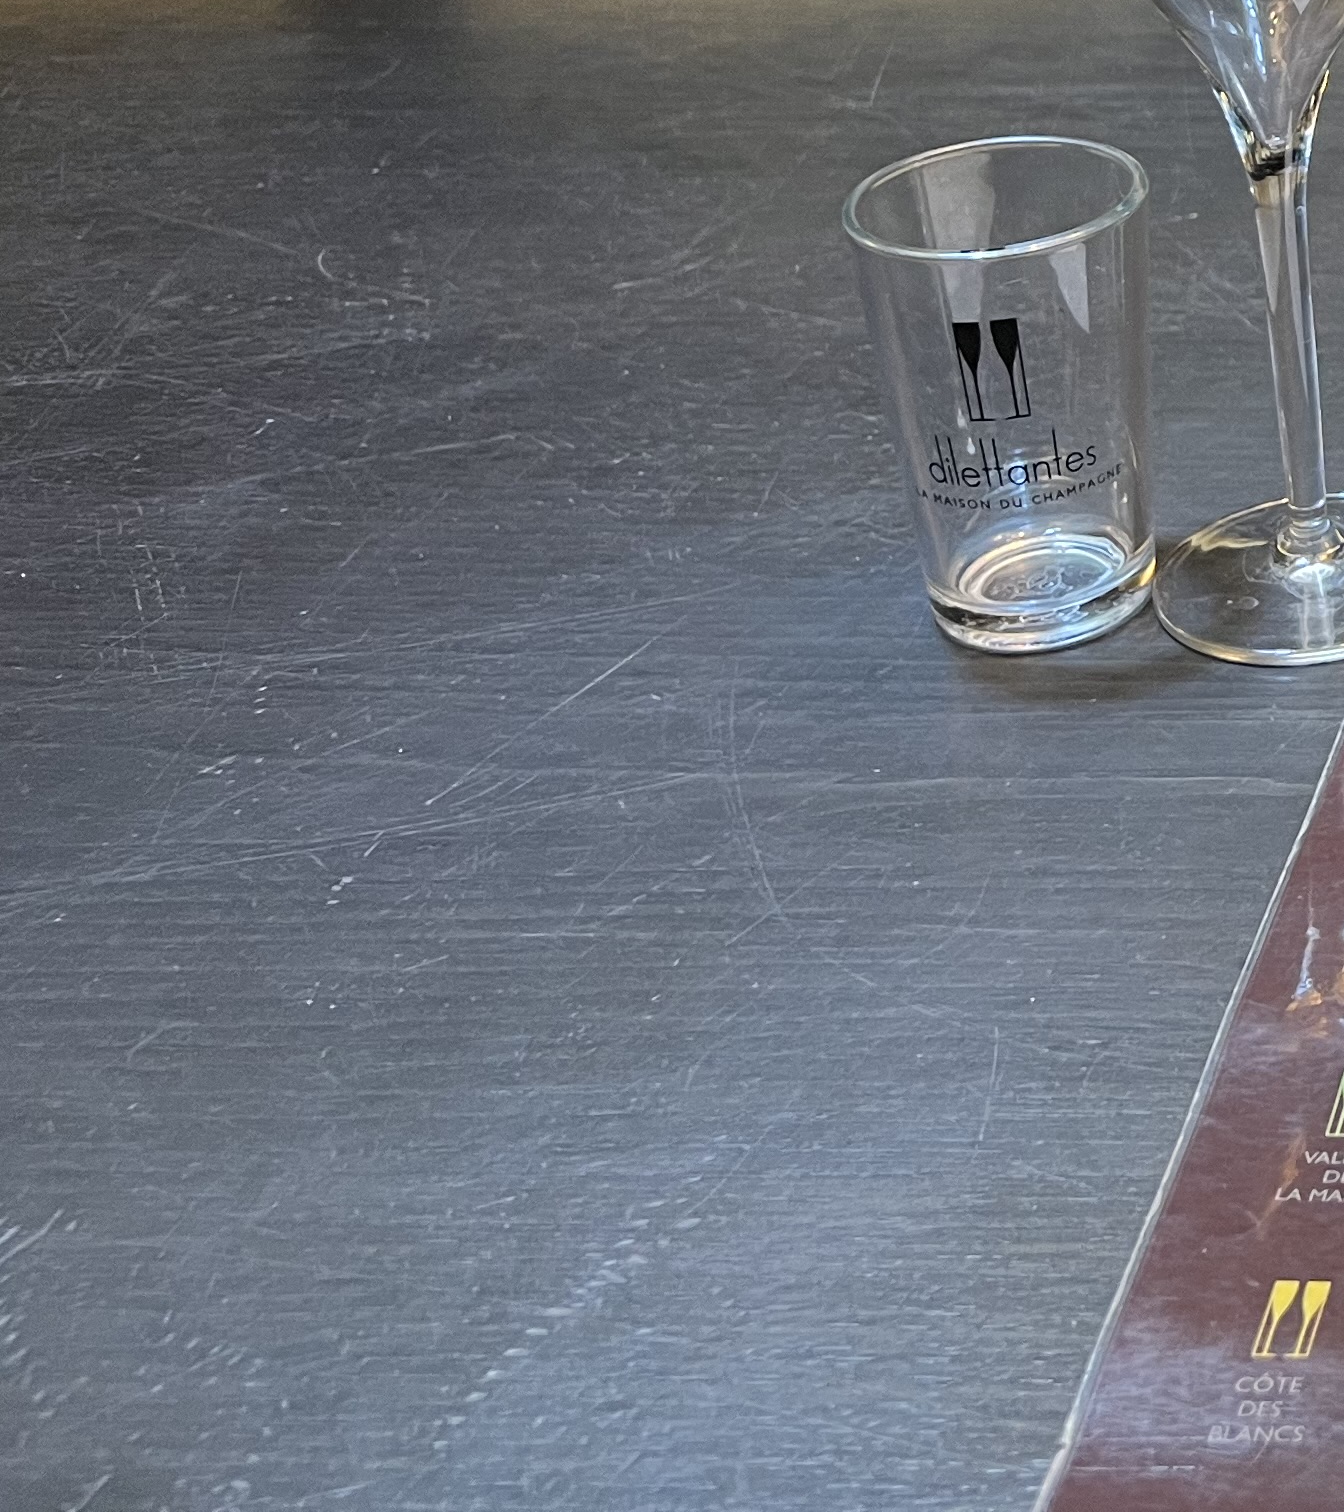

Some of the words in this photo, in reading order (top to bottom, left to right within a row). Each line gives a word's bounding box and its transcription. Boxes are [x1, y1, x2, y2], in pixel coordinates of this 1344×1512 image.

[929, 427, 1097, 488] dilettantes
[934, 493, 991, 510] MAISON
[1000, 499, 1023, 510] DU
[1031, 462, 1123, 505] CHAMPAGNE
[1274, 1187, 1301, 1203] LA
[1234, 1371, 1305, 1394] CÔTE
[1237, 1400, 1284, 1418] DES
[1206, 1425, 1306, 1443] BLANCS
